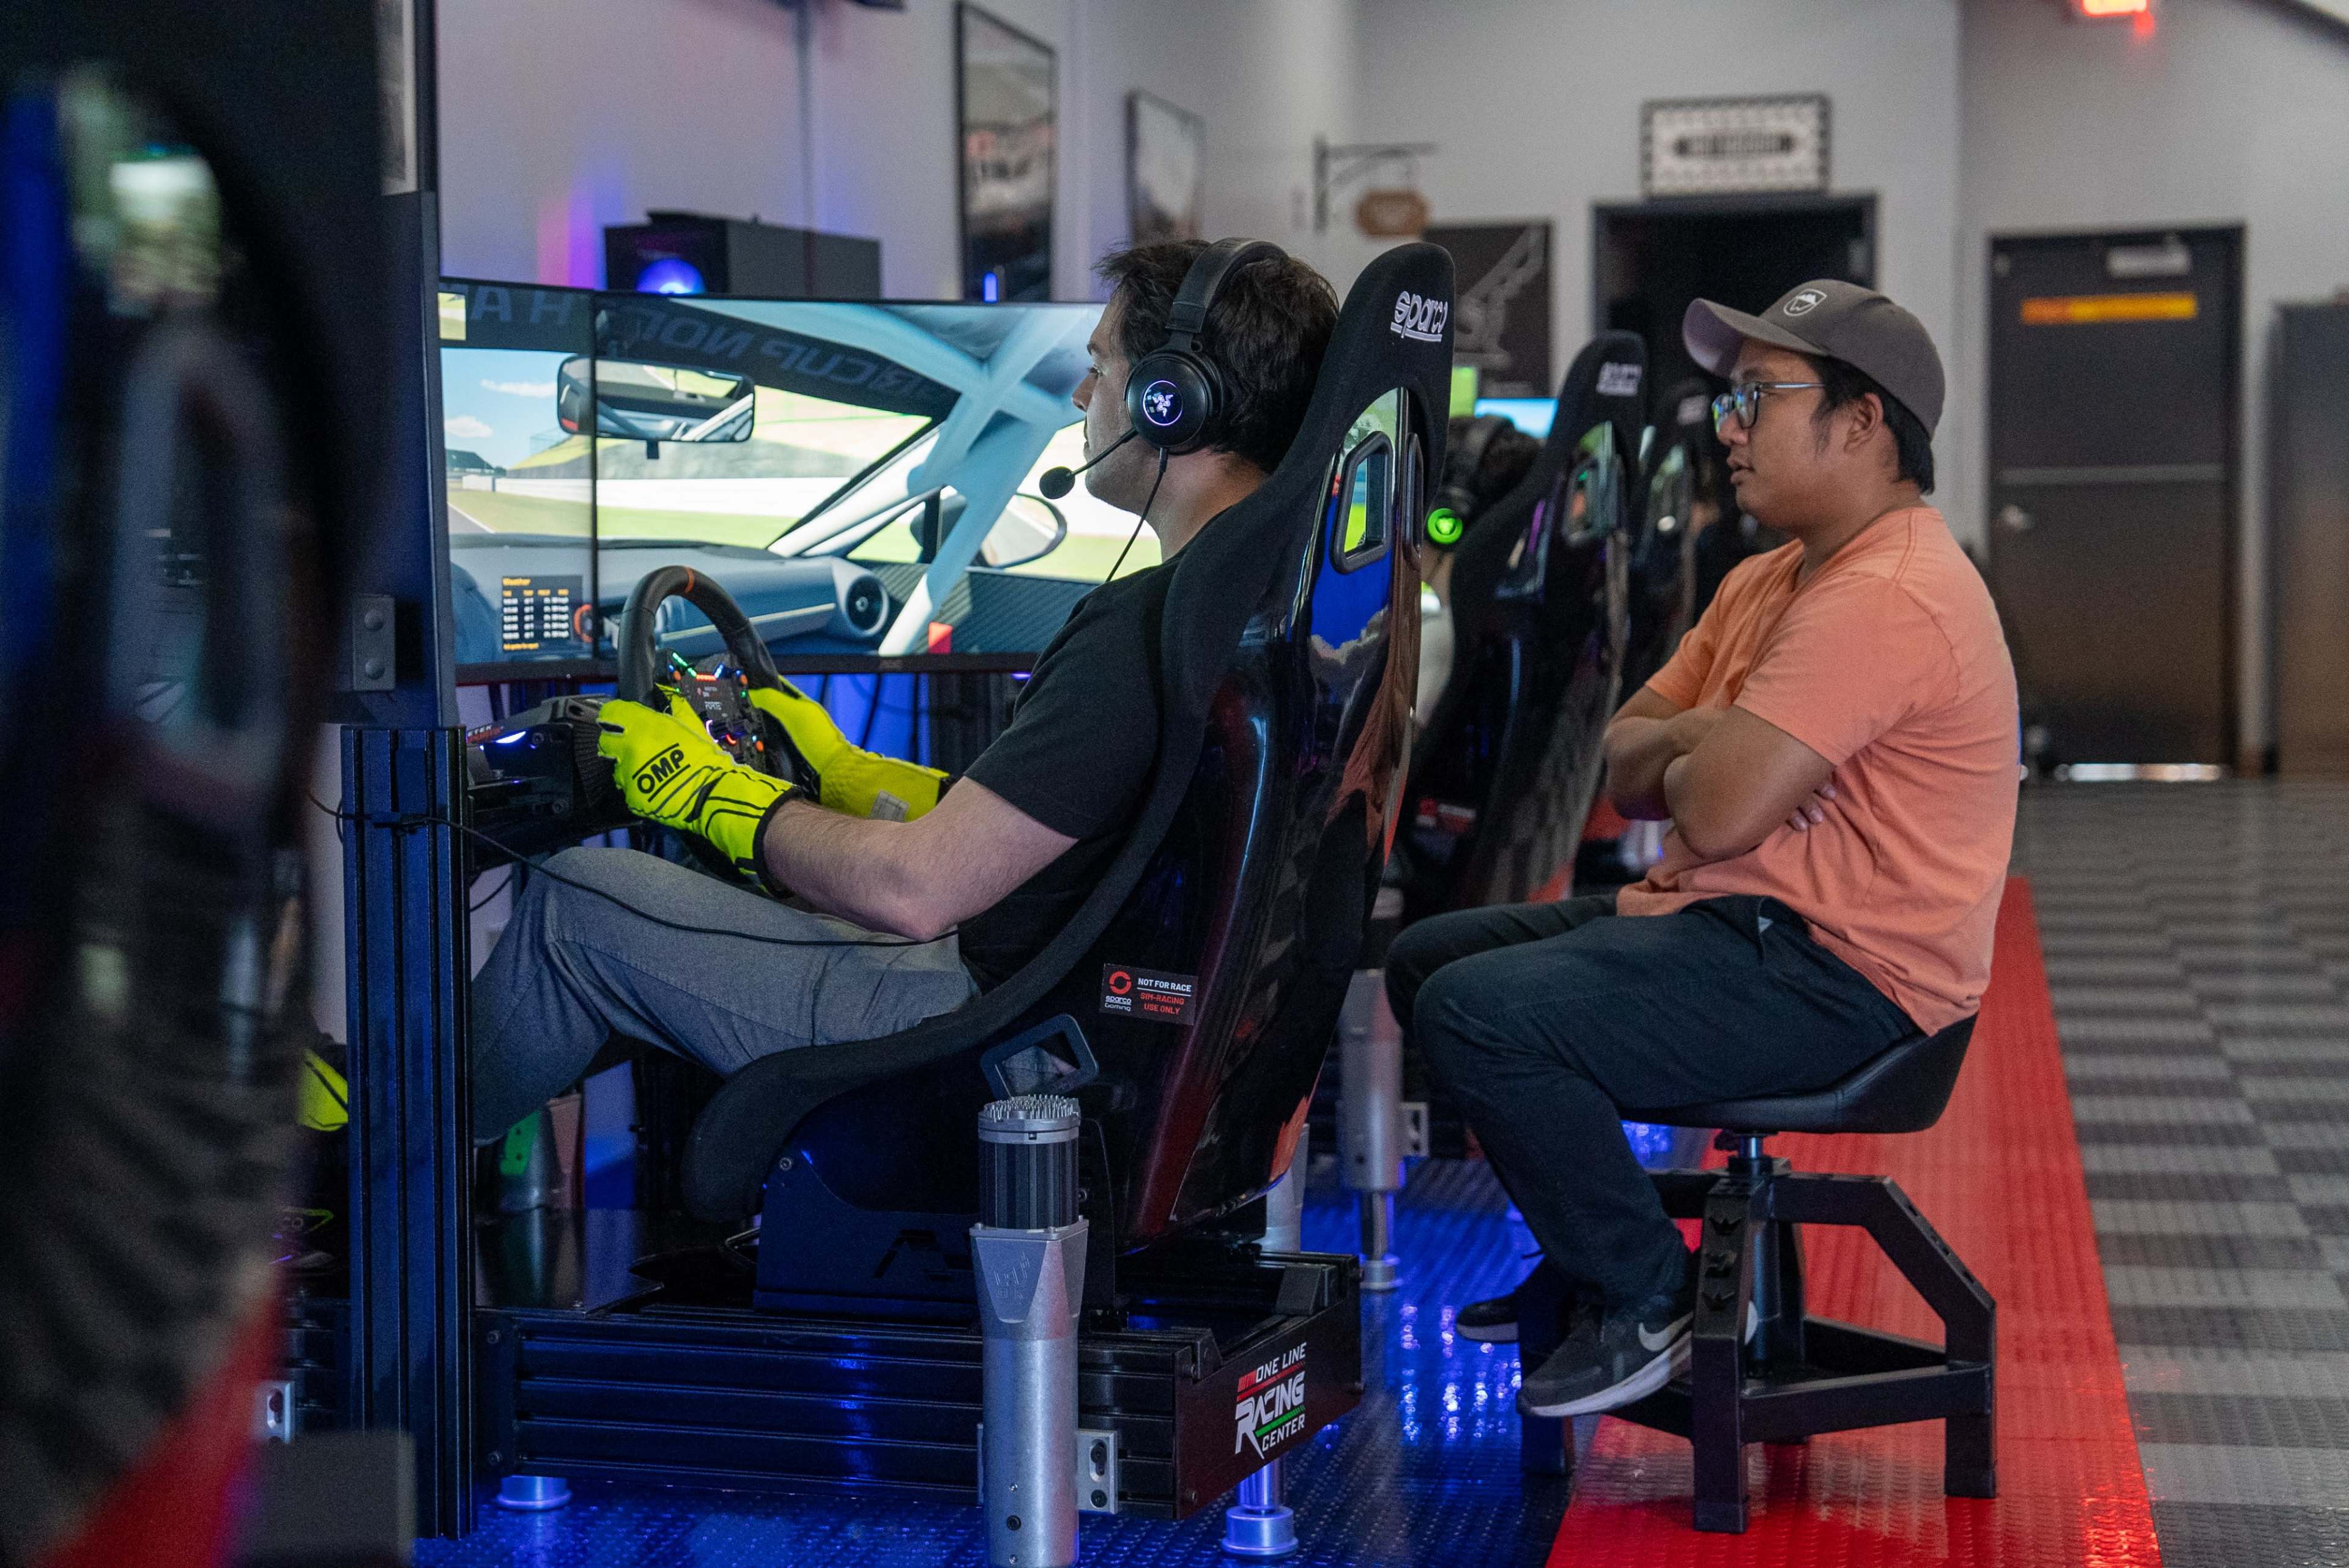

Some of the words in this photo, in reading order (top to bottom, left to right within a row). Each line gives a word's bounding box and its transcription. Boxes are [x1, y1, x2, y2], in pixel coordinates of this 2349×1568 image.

[1393, 290, 1448, 339] sparco
[637, 749, 684, 794] OMP
[1105, 995, 1132, 1005] sparco
[1138, 978, 1152, 986] NOT
[1154, 980, 1169, 989] FOR
[1170, 983, 1192, 992] RACE
[1140, 992, 1184, 1005] SIM-RACING
[1144, 1003, 1159, 1012] USE
[1160, 1005, 1181, 1015] ONLY
[1255, 1356, 1280, 1383] ONE
[1282, 1342, 1307, 1369] LINE
[1235, 1370, 1306, 1460] RACING
[1262, 1413, 1305, 1452] CENTER
